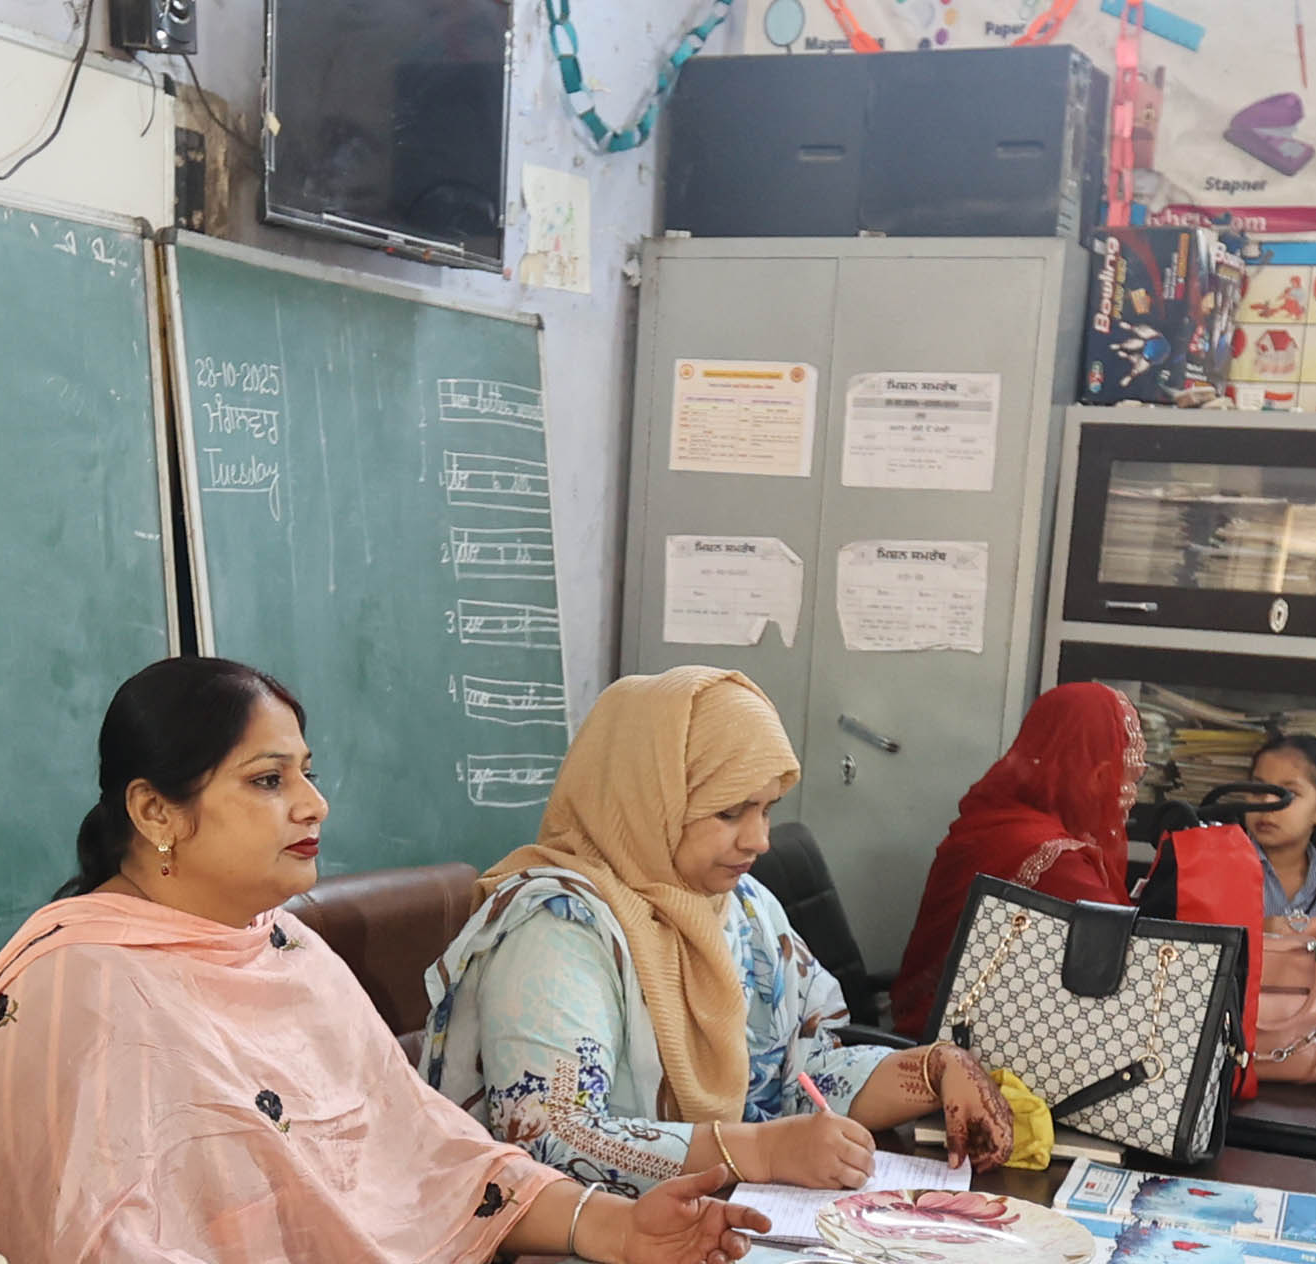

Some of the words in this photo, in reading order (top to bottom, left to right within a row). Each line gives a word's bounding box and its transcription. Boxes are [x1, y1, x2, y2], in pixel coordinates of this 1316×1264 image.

[1204, 176, 1268, 194] Stapner
[1093, 236, 1121, 334] Bowling
[194, 356, 281, 395] 28-10-2025
[202, 448, 282, 522] Tuesday
